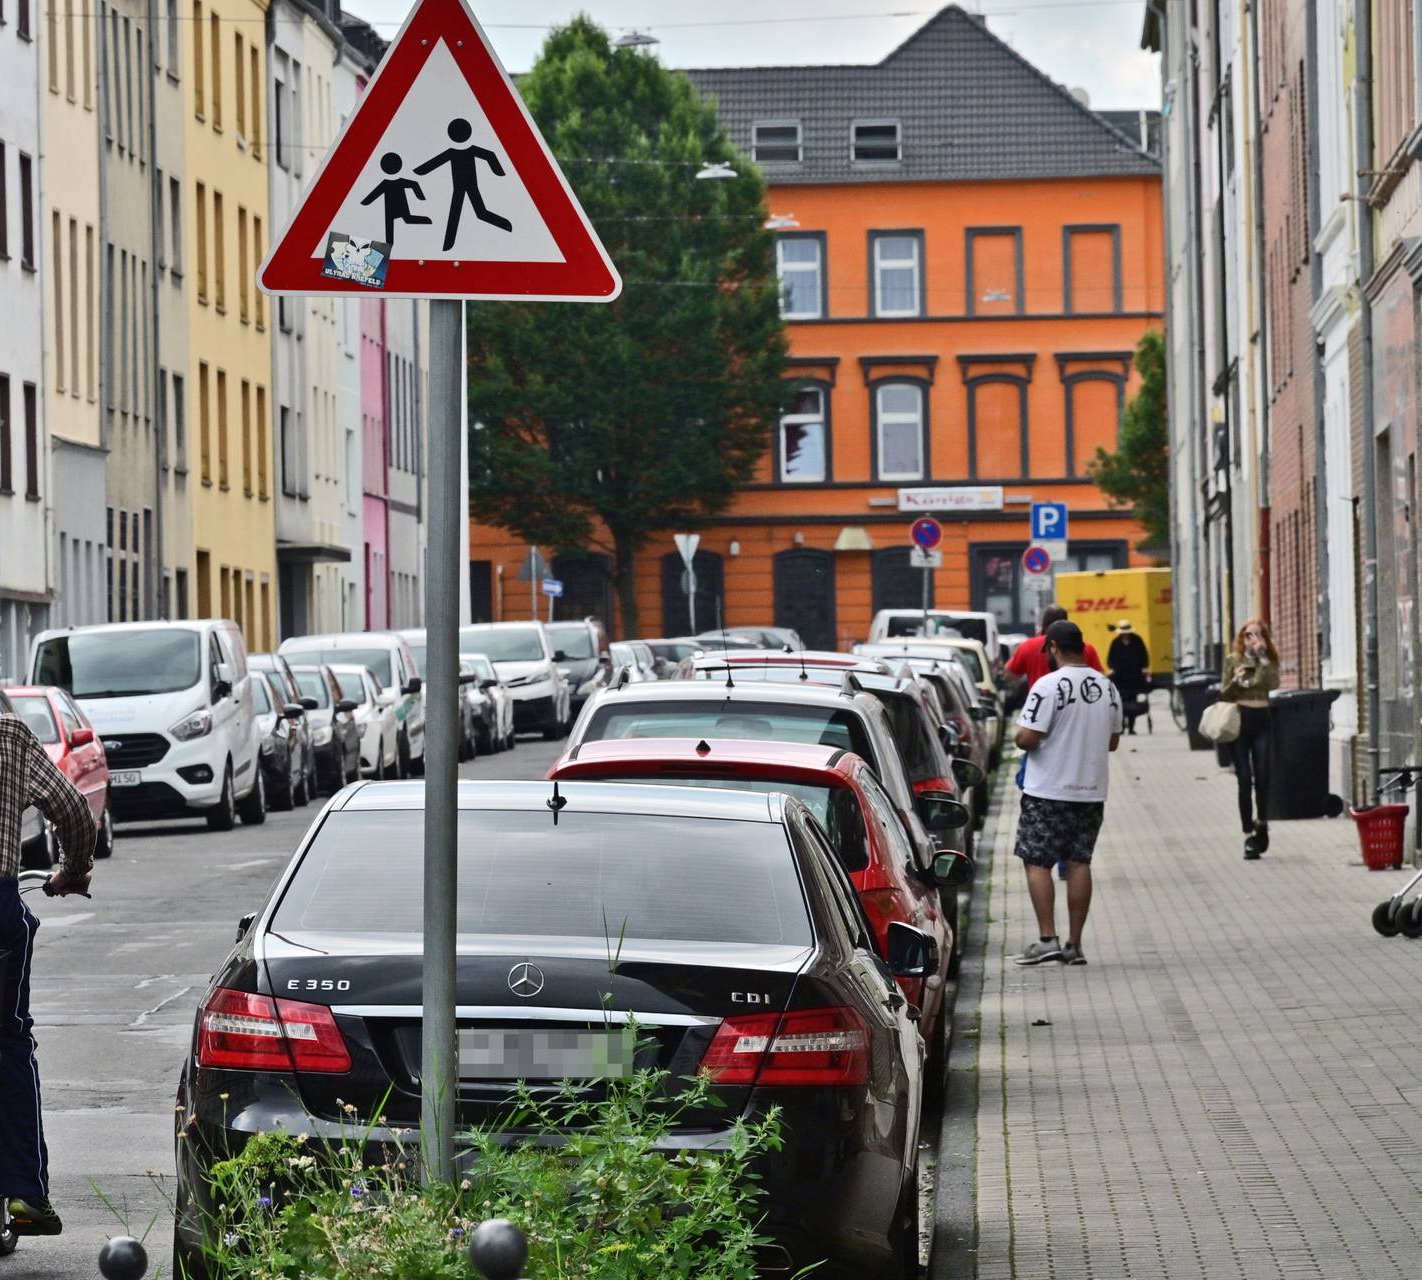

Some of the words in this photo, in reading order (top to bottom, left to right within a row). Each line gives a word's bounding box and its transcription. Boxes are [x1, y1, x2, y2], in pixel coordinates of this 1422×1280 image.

[1039, 507, 1060, 536] P
[1075, 597, 1130, 613] DHL
[287, 979, 300, 990] E
[305, 979, 350, 991] 350
[731, 991, 771, 1005] CDI
